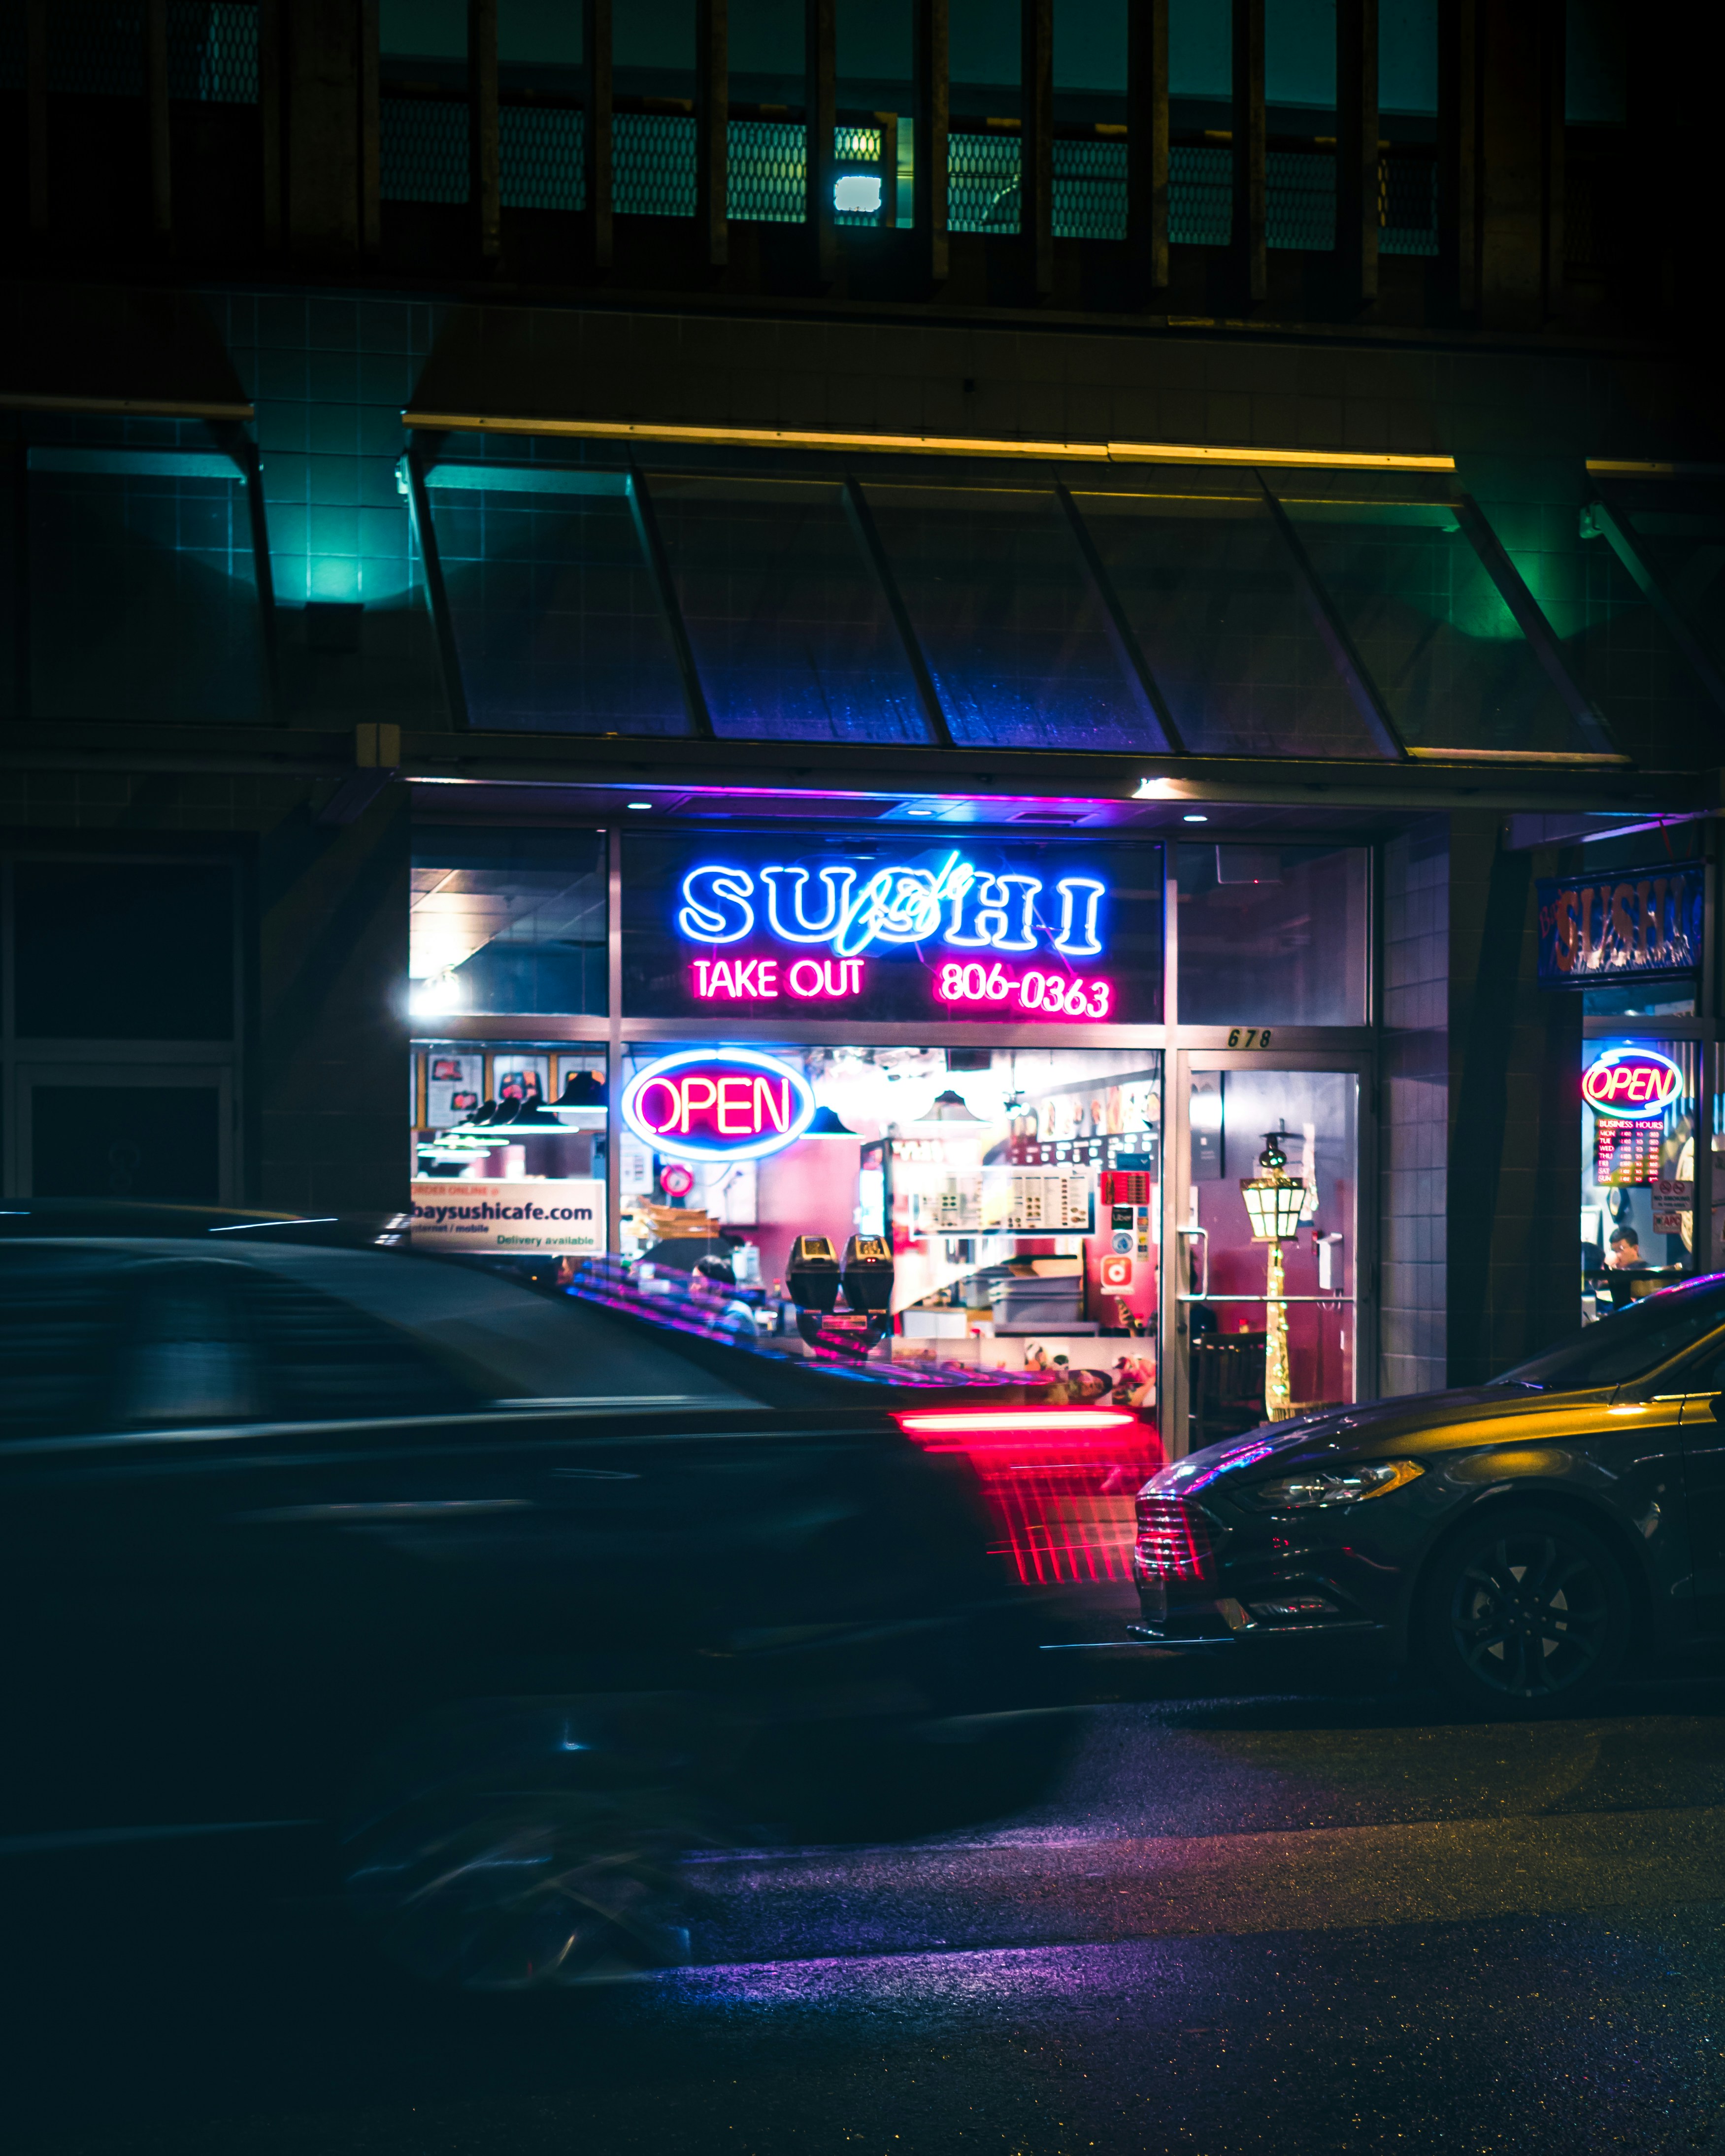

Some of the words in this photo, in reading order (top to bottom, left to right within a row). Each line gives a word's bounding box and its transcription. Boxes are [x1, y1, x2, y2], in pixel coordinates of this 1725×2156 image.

[678, 865, 1105, 956] SUSHI
[1555, 875, 1688, 972] SUSHI
[693, 959, 778, 998] TAKE
[789, 959, 864, 996] OUT
[940, 962, 1110, 1018] 806-0363
[1227, 1028, 1272, 1048] 678
[1588, 1067, 1673, 1101] OPEN
[634, 1077, 790, 1134] OPEN
[1599, 1119, 1633, 1128] BUSINESS
[411, 1201, 593, 1224] baysushicafe.com
[497, 1235, 541, 1247] Delivery
[545, 1236, 594, 1245] available
